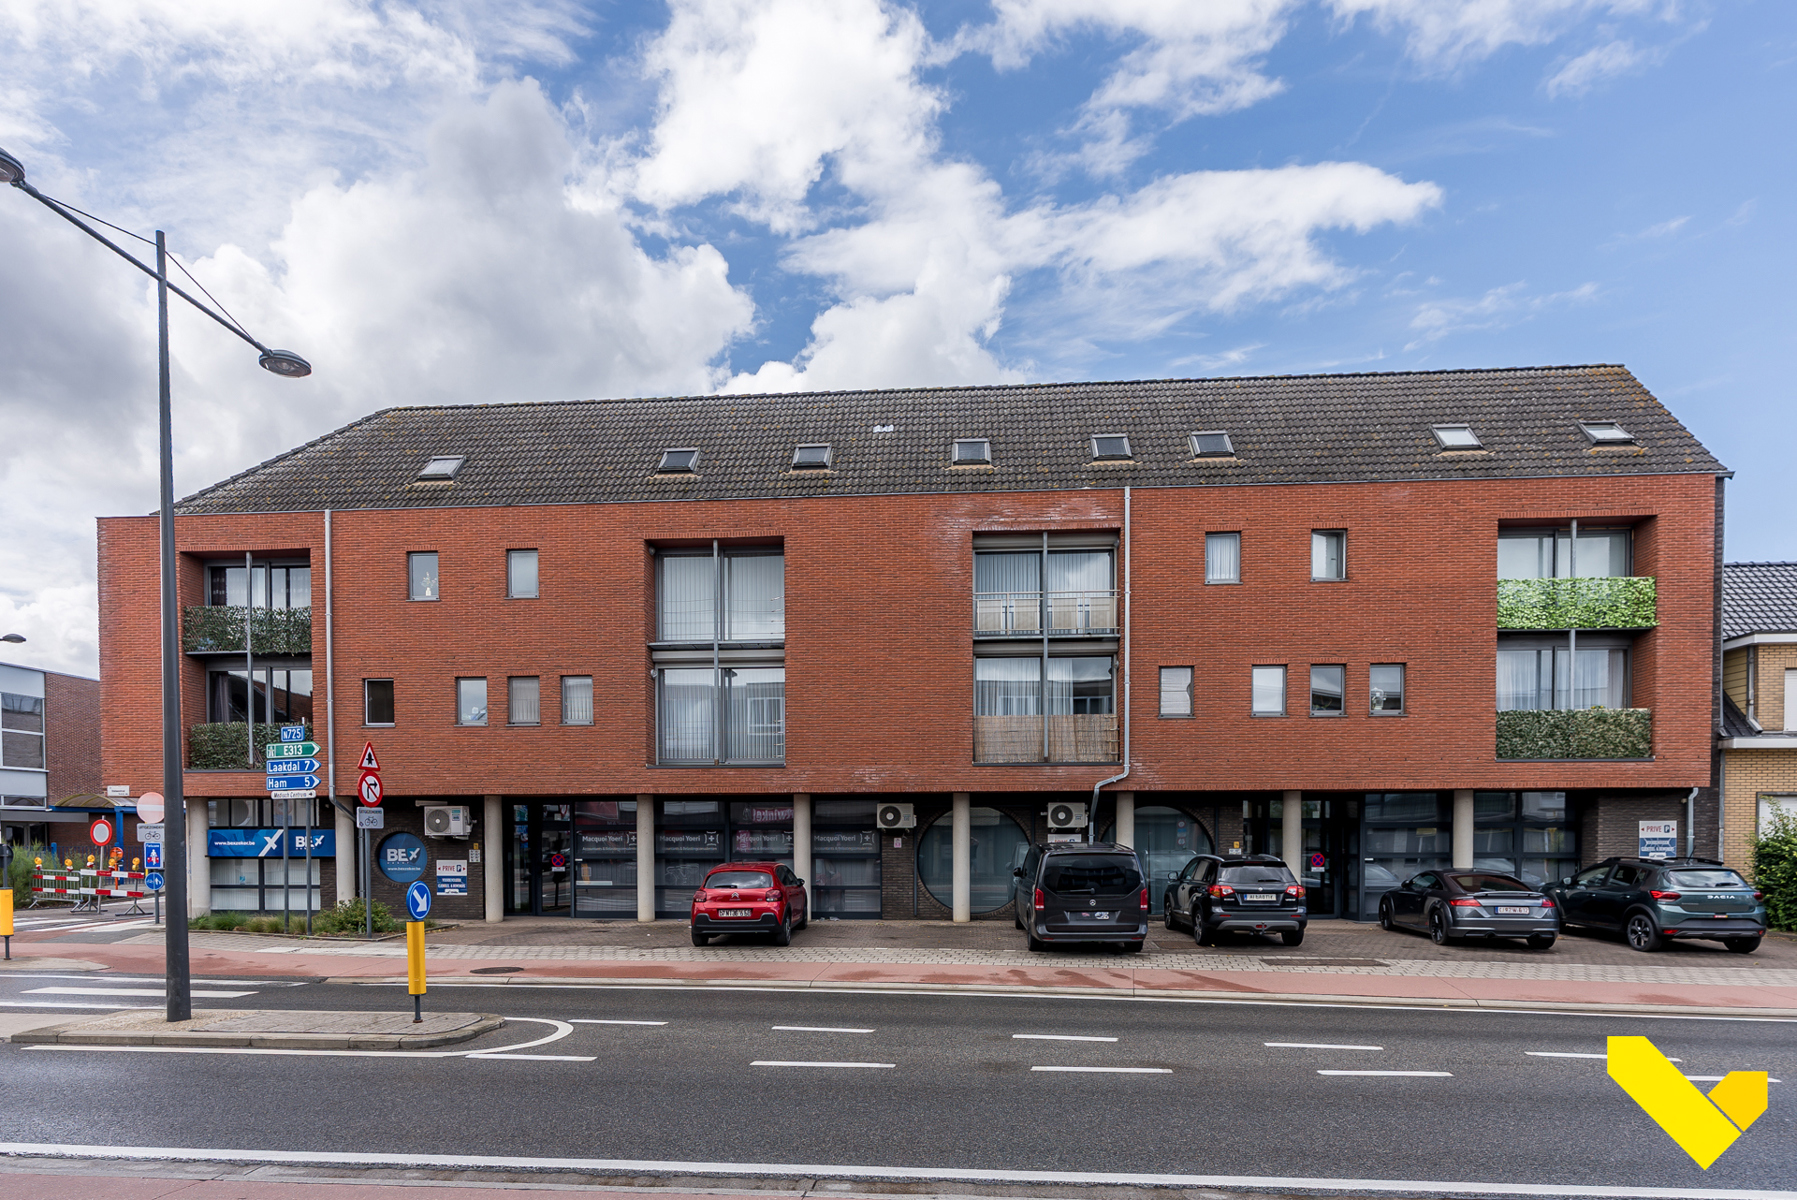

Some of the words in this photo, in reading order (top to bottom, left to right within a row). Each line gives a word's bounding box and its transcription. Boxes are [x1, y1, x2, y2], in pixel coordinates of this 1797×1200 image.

[283, 728, 301, 739] N725
[283, 744, 303, 756] E313
[268, 760, 300, 772] Laakdal
[304, 760, 310, 771] 7
[268, 778, 287, 788] Ham
[304, 776, 310, 787] 5
[386, 847, 421, 862] BEX
